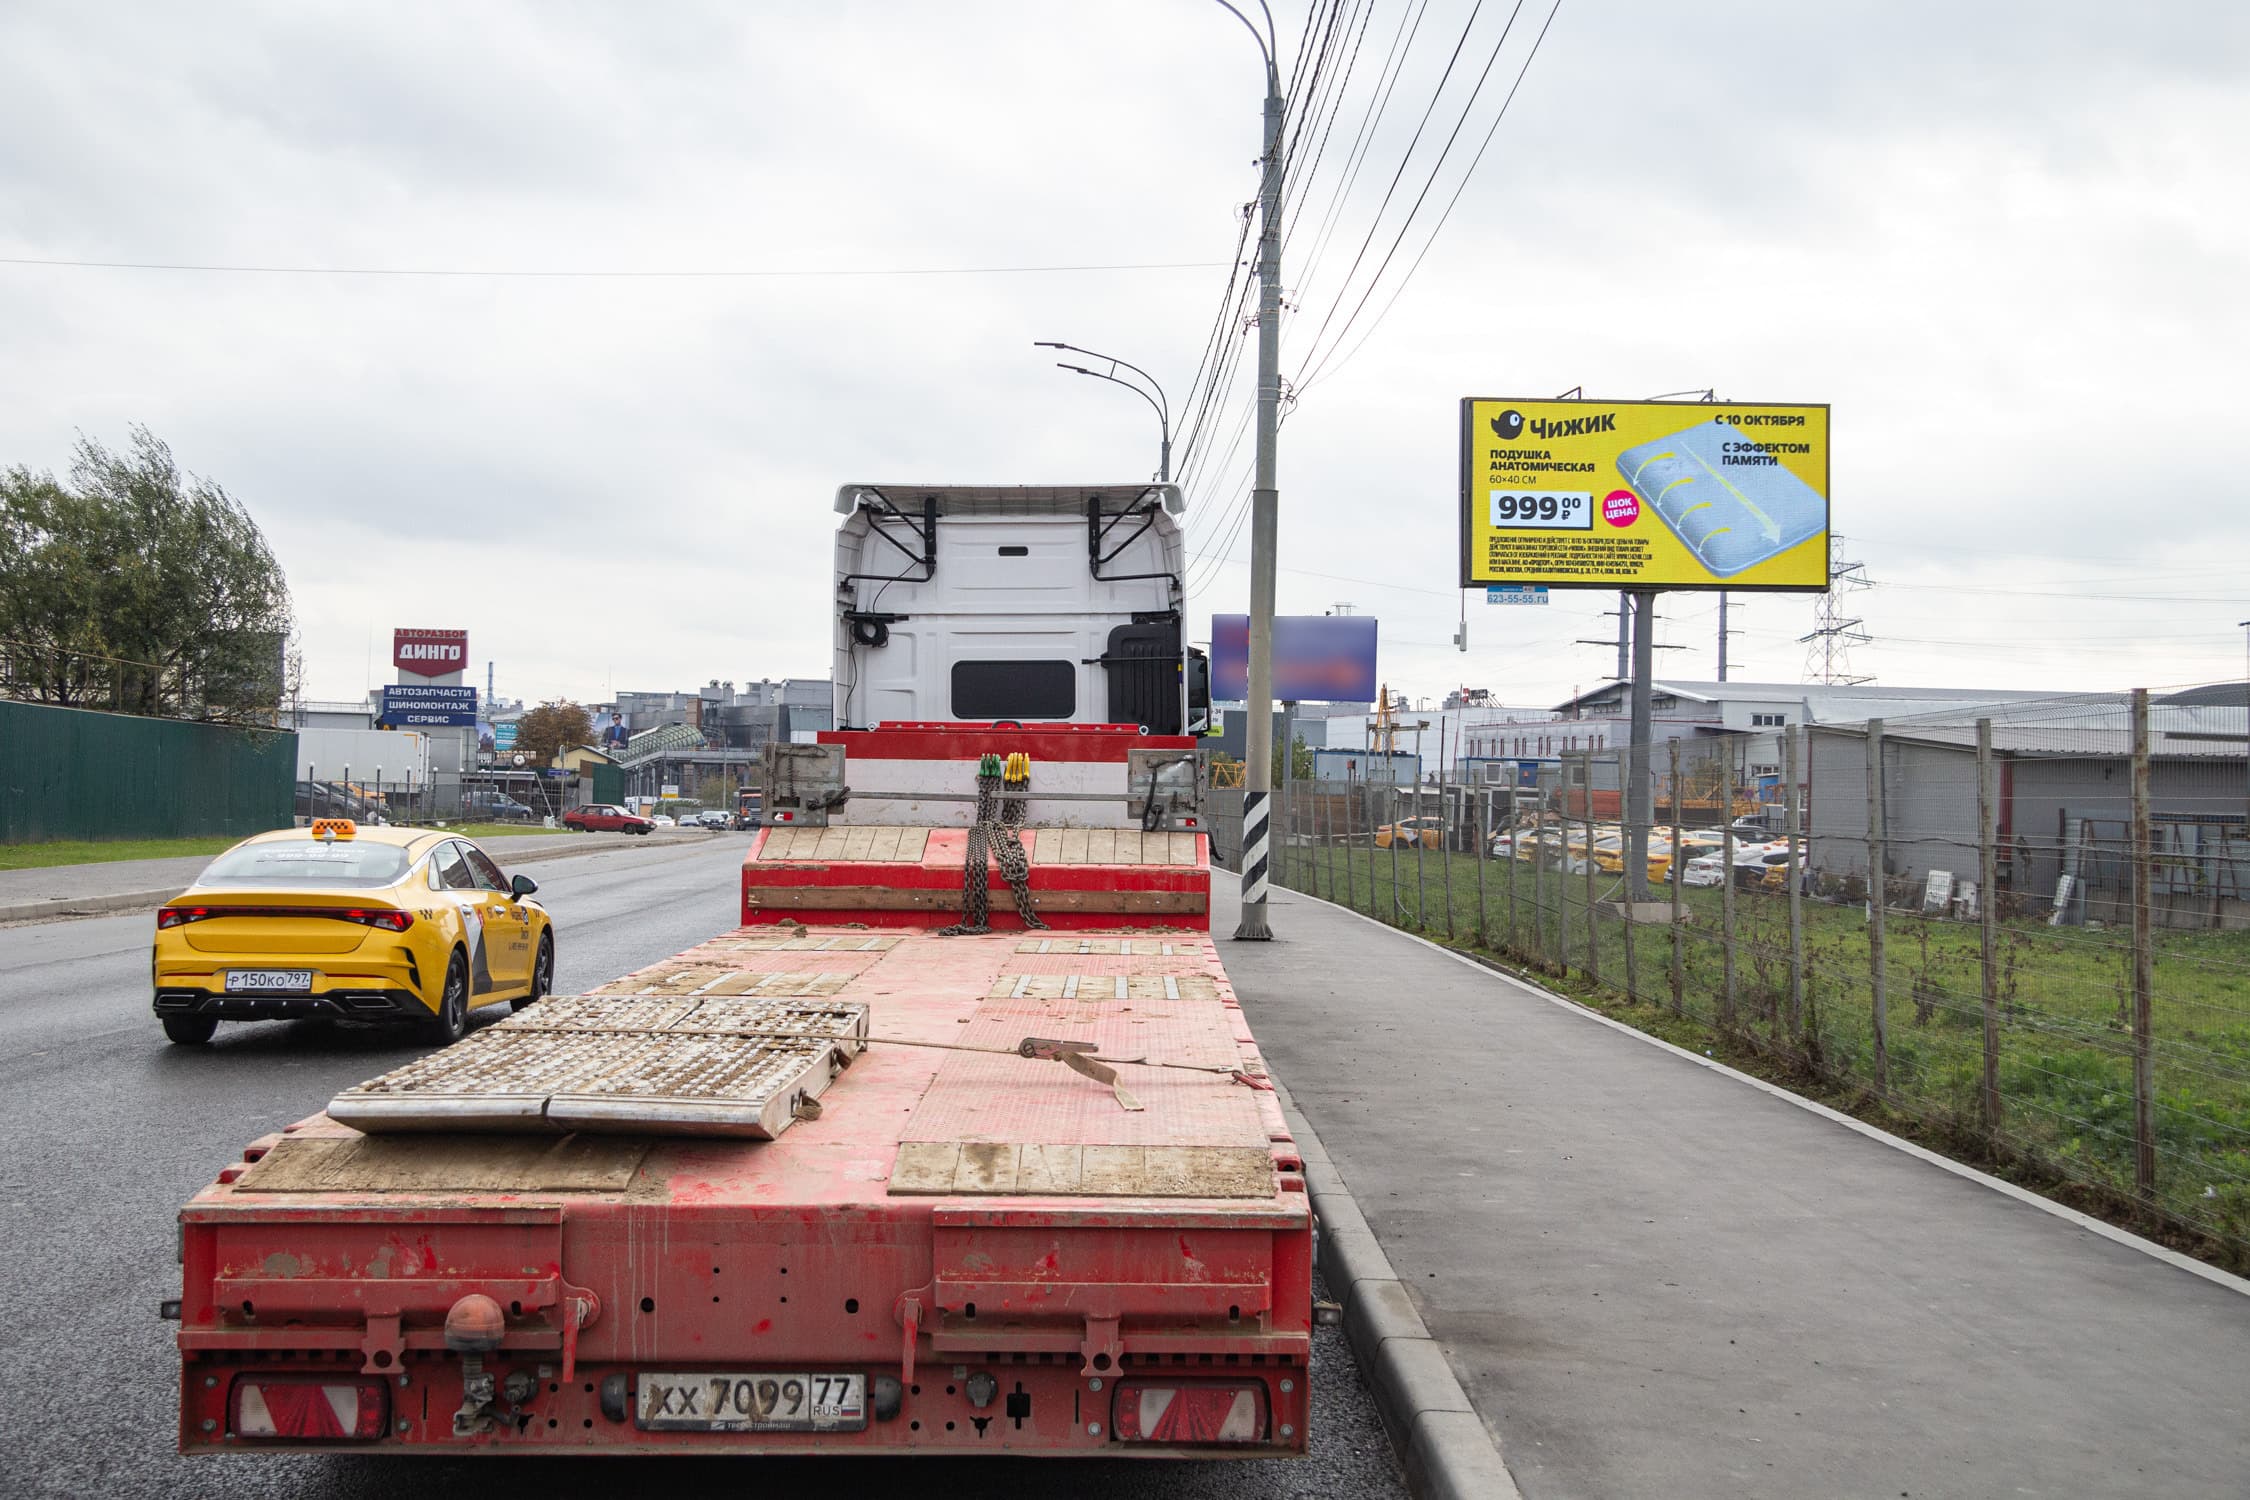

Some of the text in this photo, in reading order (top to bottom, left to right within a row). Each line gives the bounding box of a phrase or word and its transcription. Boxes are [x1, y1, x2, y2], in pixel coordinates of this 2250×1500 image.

[1714, 414, 1805, 426] С 10 ОКТЯБРЯ
[1530, 413, 1616, 440] ЧИЖИК
[1722, 442, 1810, 454] С ЭФФЕКТОМ
[1489, 449, 1551, 460] ПОДУШКА
[1722, 455, 1778, 466] ПАМЯТИ
[1489, 461, 1595, 473] АНАТОМИЧЕСКАЯ
[1522, 475, 1537, 485] СМ
[1498, 495, 1581, 520] 999 00
[1607, 497, 1633, 509] ШОК
[1605, 507, 1637, 520] ЦЕНА!
[1487, 593, 1549, 605] 623-55-55.ru
[396, 628, 466, 638] АВТОРАЗБОР
[399, 643, 461, 661] ДИНГО
[388, 687, 472, 697] АВТОЗАПЧАСТИ
[388, 700, 470, 710] ШИНОМОНТАЖ
[407, 714, 450, 724] СЕРВИС
[287, 972, 308, 984] 797
[814, 1377, 851, 1405] 77
[813, 1406, 840, 1416] RUS
